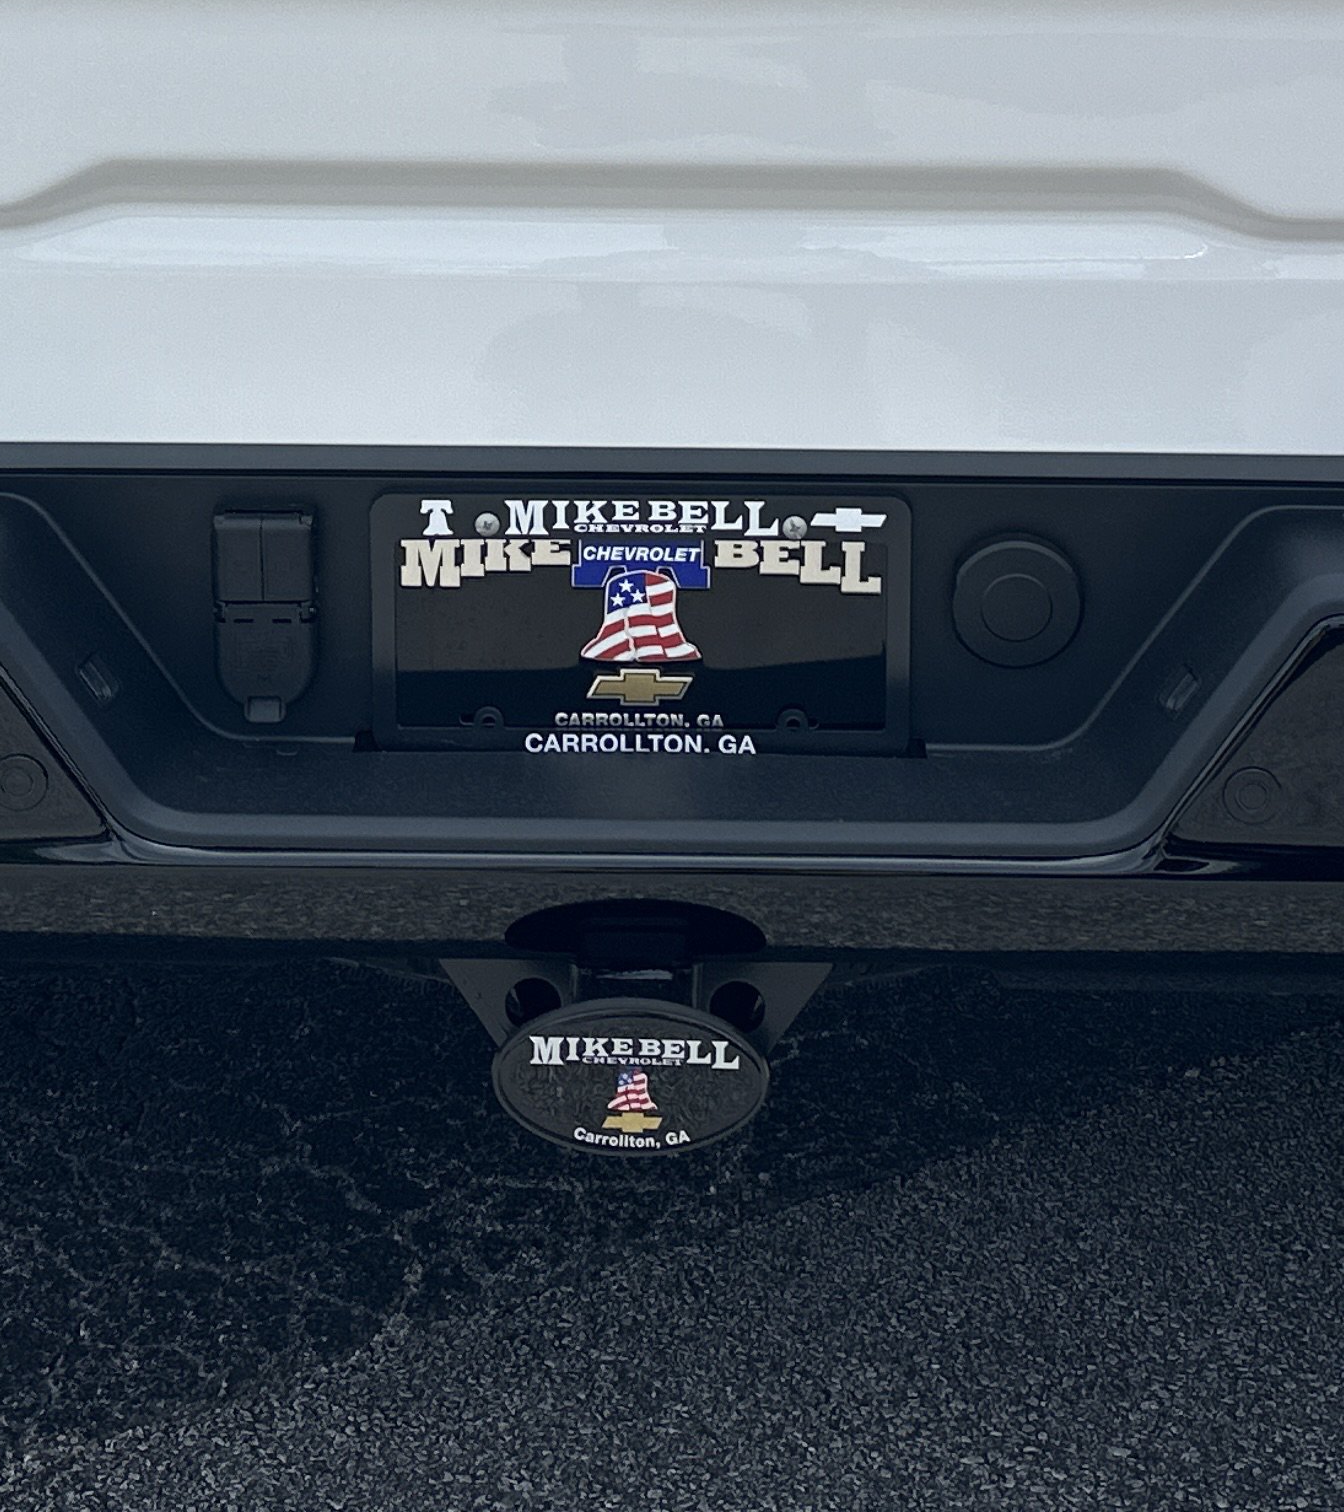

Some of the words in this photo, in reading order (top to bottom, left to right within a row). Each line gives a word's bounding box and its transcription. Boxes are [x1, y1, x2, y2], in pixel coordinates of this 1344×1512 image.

[504, 499, 641, 536] MIKE
[647, 499, 781, 537] BELL
[574, 523, 707, 534] CHEVROLET
[583, 545, 701, 563] CHEVROLET
[400, 538, 571, 587] MIKE
[714, 539, 882, 594] BELL
[697, 713, 724, 727] GA
[718, 734, 757, 755] GA
[529, 1035, 634, 1066] MIKE
[639, 1039, 740, 1070] BELL
[581, 1056, 683, 1066] CHEVROLET
[573, 1127, 660, 1149] Carrollton,
[665, 1129, 691, 1146] GA
